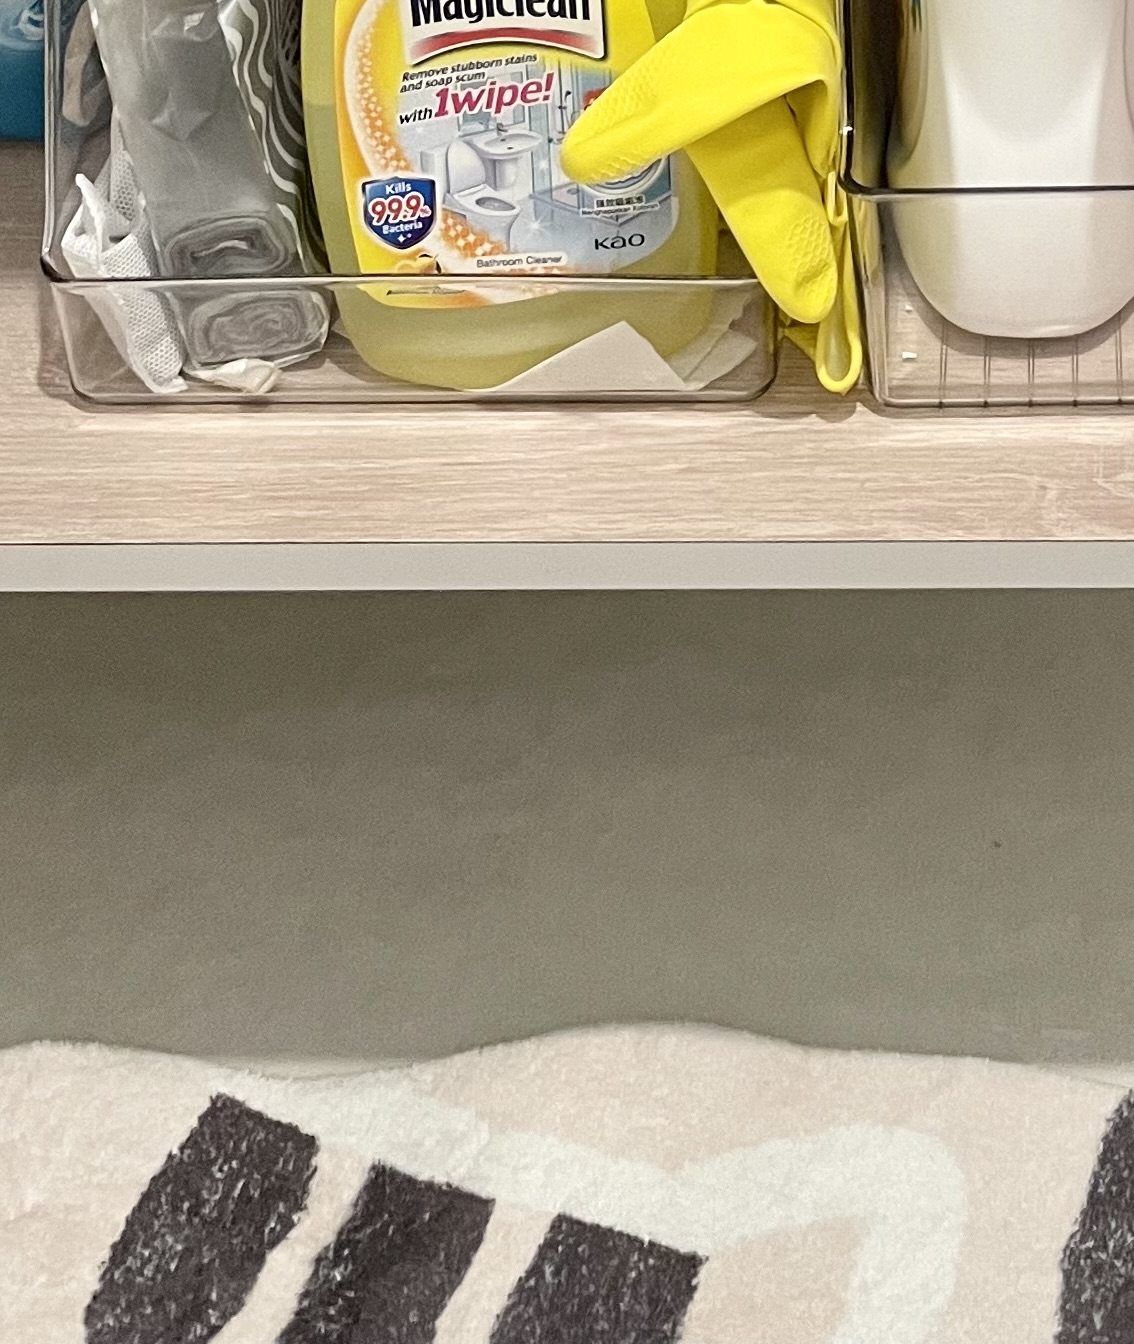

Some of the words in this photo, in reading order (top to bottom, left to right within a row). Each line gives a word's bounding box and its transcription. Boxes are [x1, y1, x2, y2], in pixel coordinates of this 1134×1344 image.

[402, 66, 449, 83] Remove
[450, 58, 503, 73] stubborn
[505, 53, 538, 66] stains
[400, 80, 423, 93] and
[425, 75, 453, 88] soap
[455, 71, 486, 83] scum
[399, 107, 433, 125] with
[385, 181, 412, 195] Kills
[382, 219, 423, 234] Bacteria
[476, 258, 524, 268] Bathroom
[526, 255, 562, 264] Cleaner
